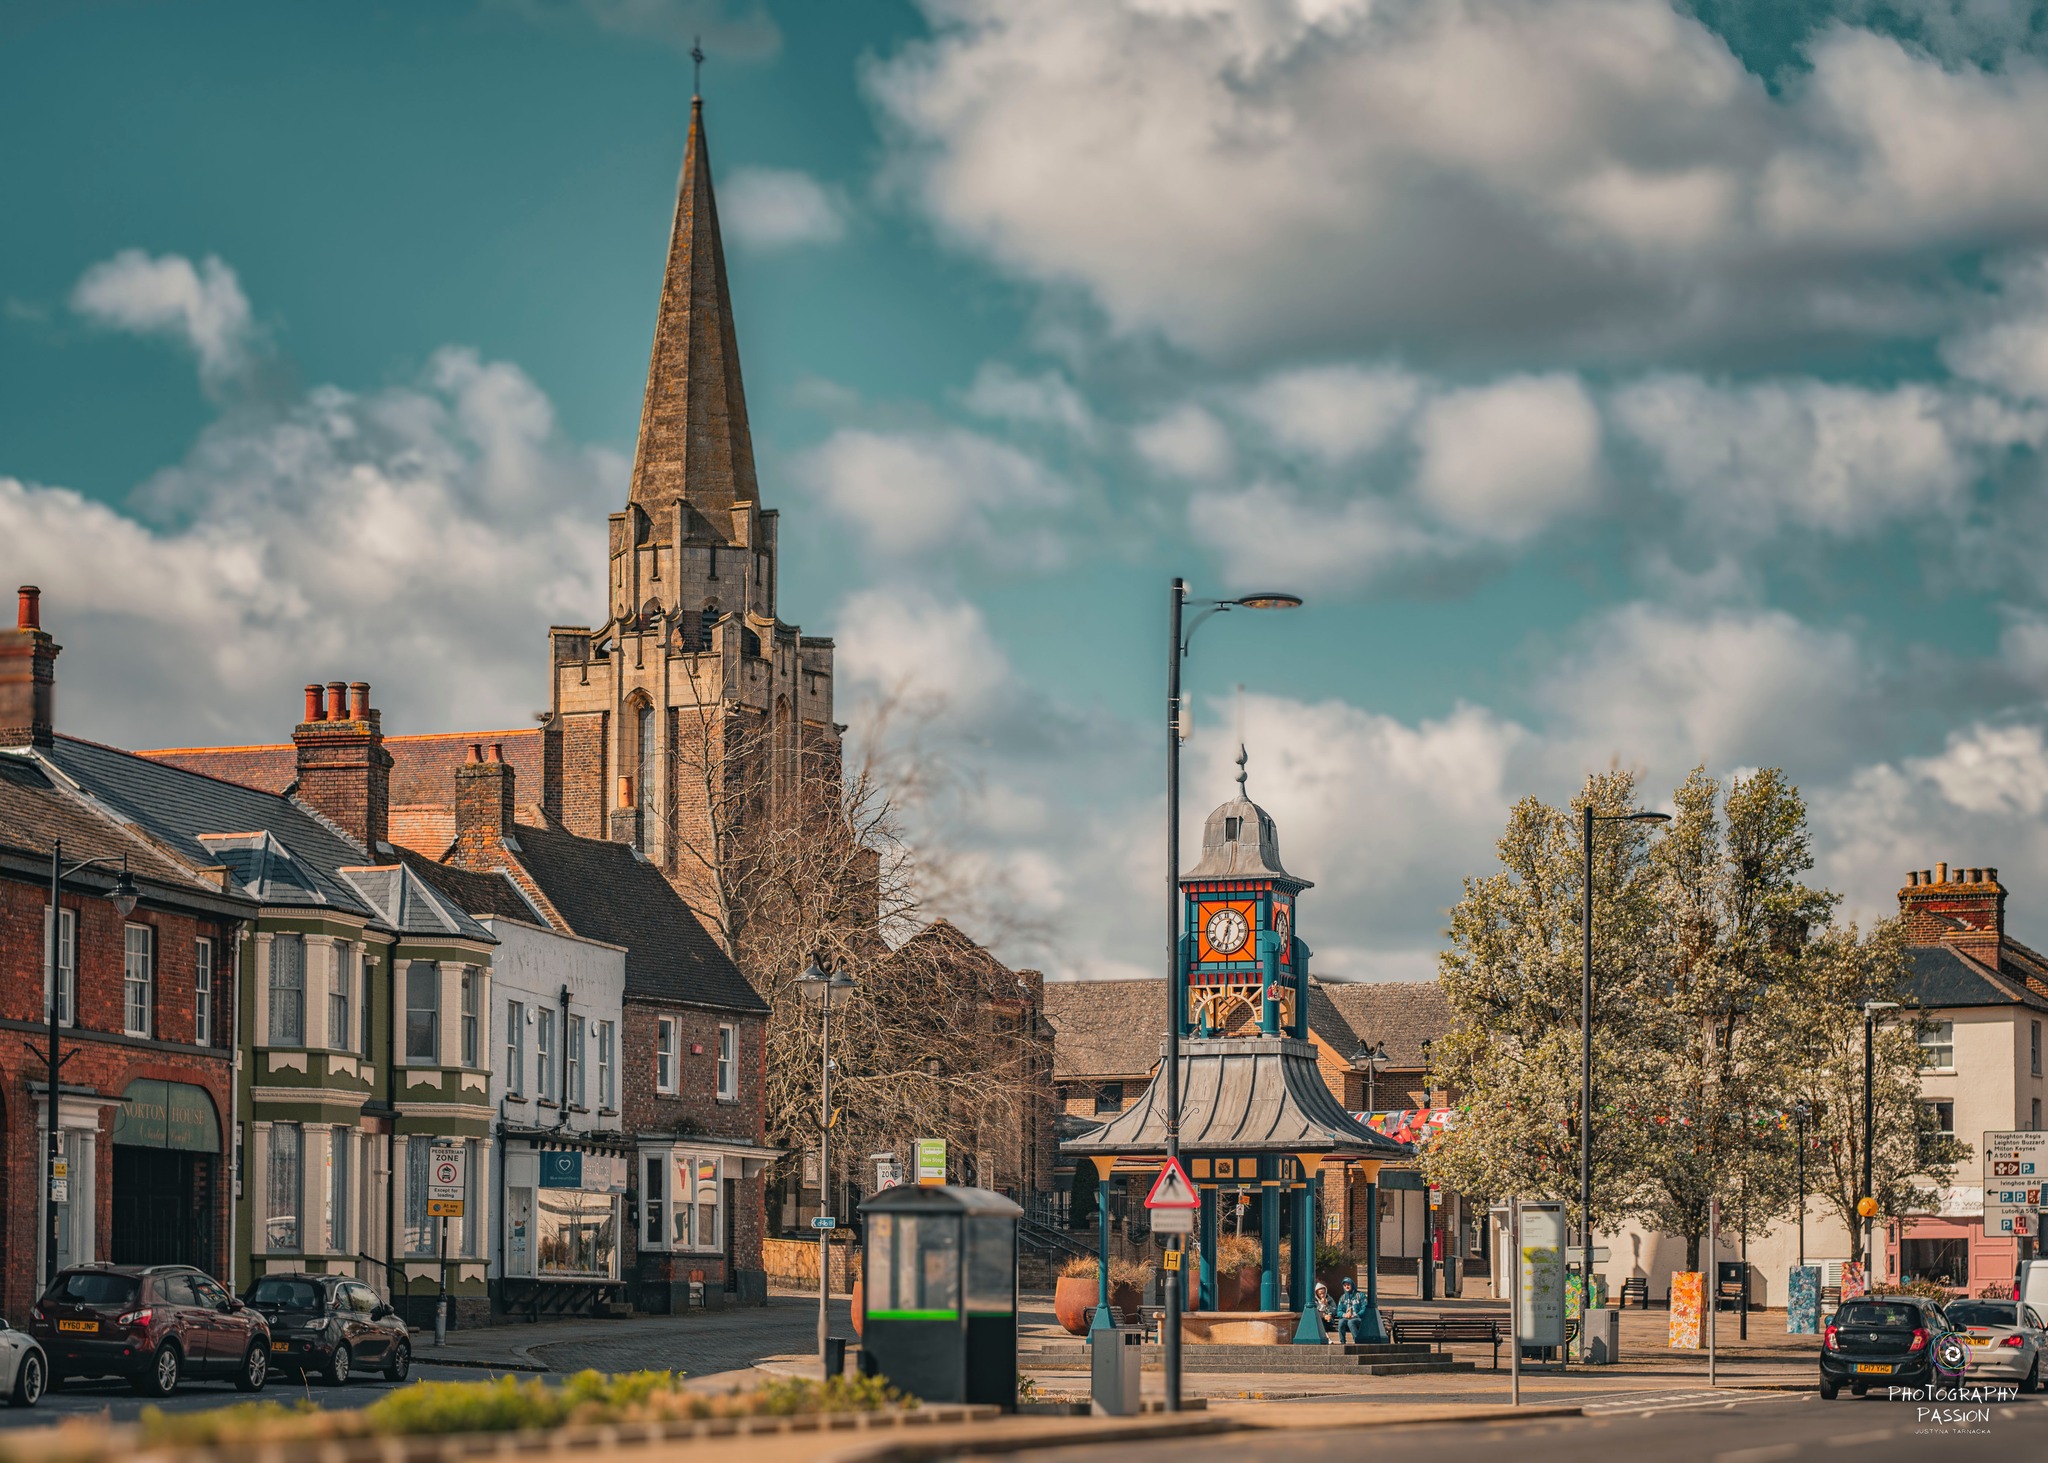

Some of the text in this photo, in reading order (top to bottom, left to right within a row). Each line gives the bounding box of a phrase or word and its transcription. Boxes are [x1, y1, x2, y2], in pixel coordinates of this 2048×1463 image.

[121, 1102, 205, 1125] NORTON HOUSE
[62, 1320, 96, 1331] YY60 JNF
[1859, 1364, 1875, 1372] LP17
